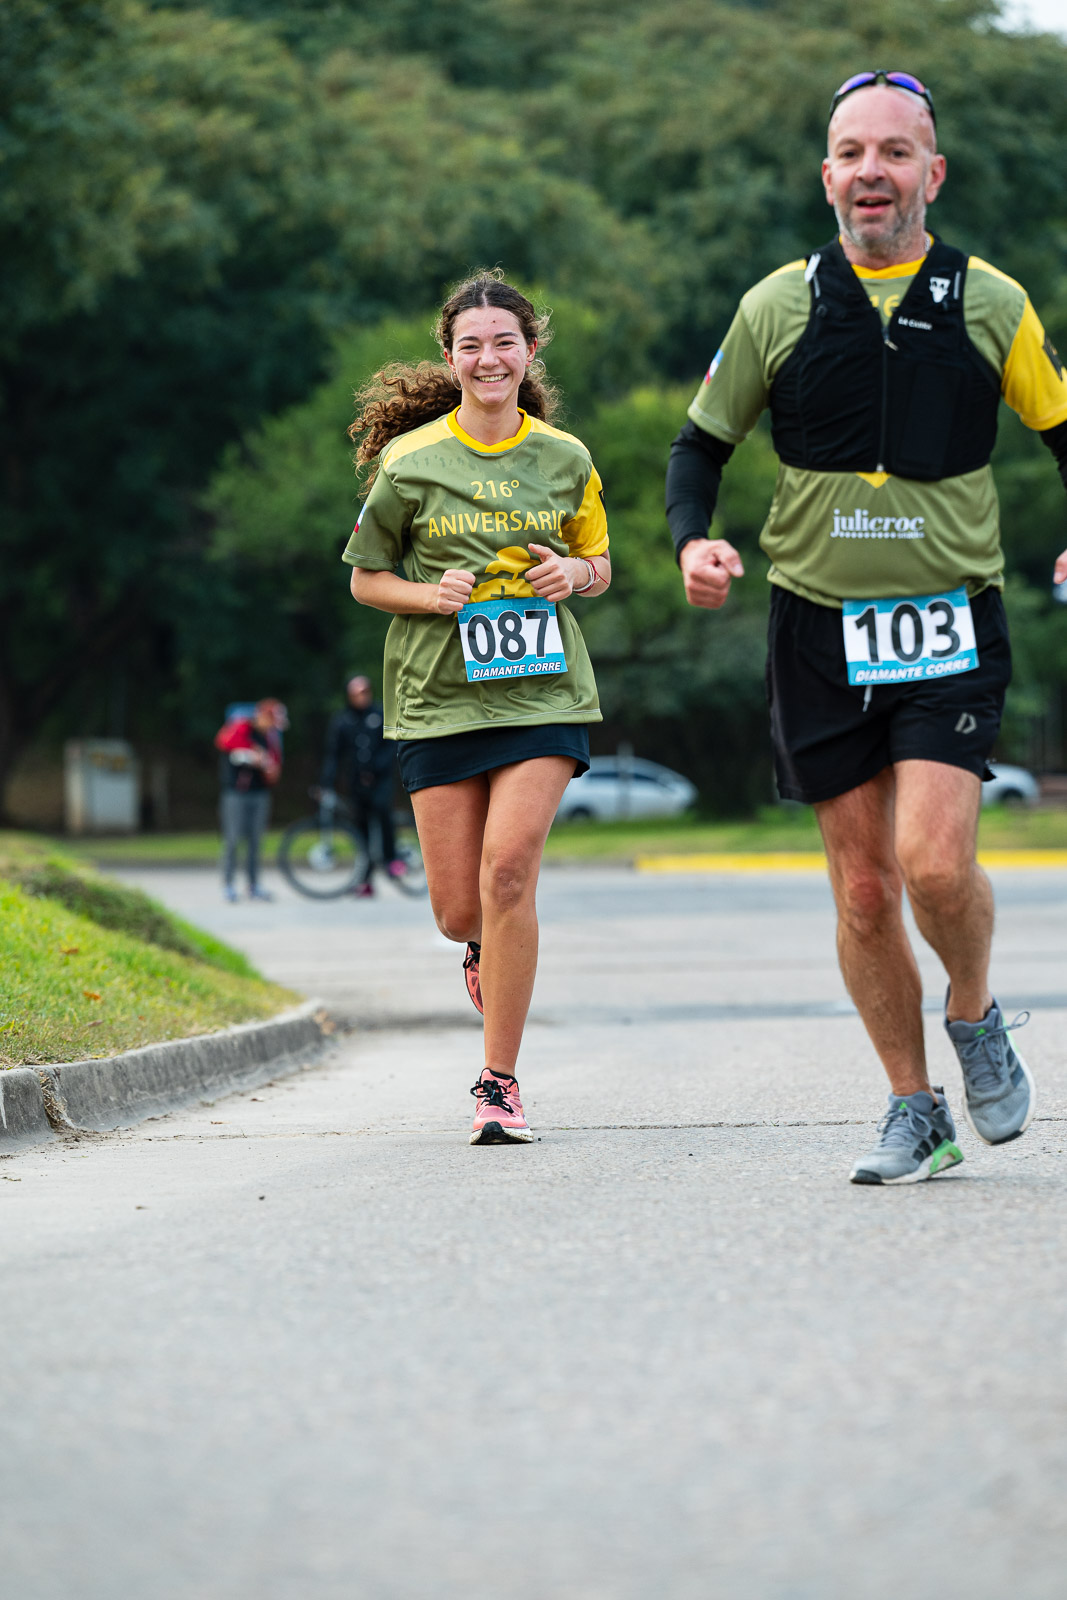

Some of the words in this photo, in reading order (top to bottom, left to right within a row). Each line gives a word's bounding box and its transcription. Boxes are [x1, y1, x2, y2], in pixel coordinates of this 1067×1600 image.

[470, 479, 520, 500] 216°
[830, 508, 925, 539] julicroc
[467, 610, 549, 664] 087
[854, 600, 961, 664] 103
[472, 664, 526, 679] DIAMANTE
[528, 661, 562, 673] CORRE
[854, 665, 924, 682] DIAMANTE
[925, 657, 971, 676] CORRE
